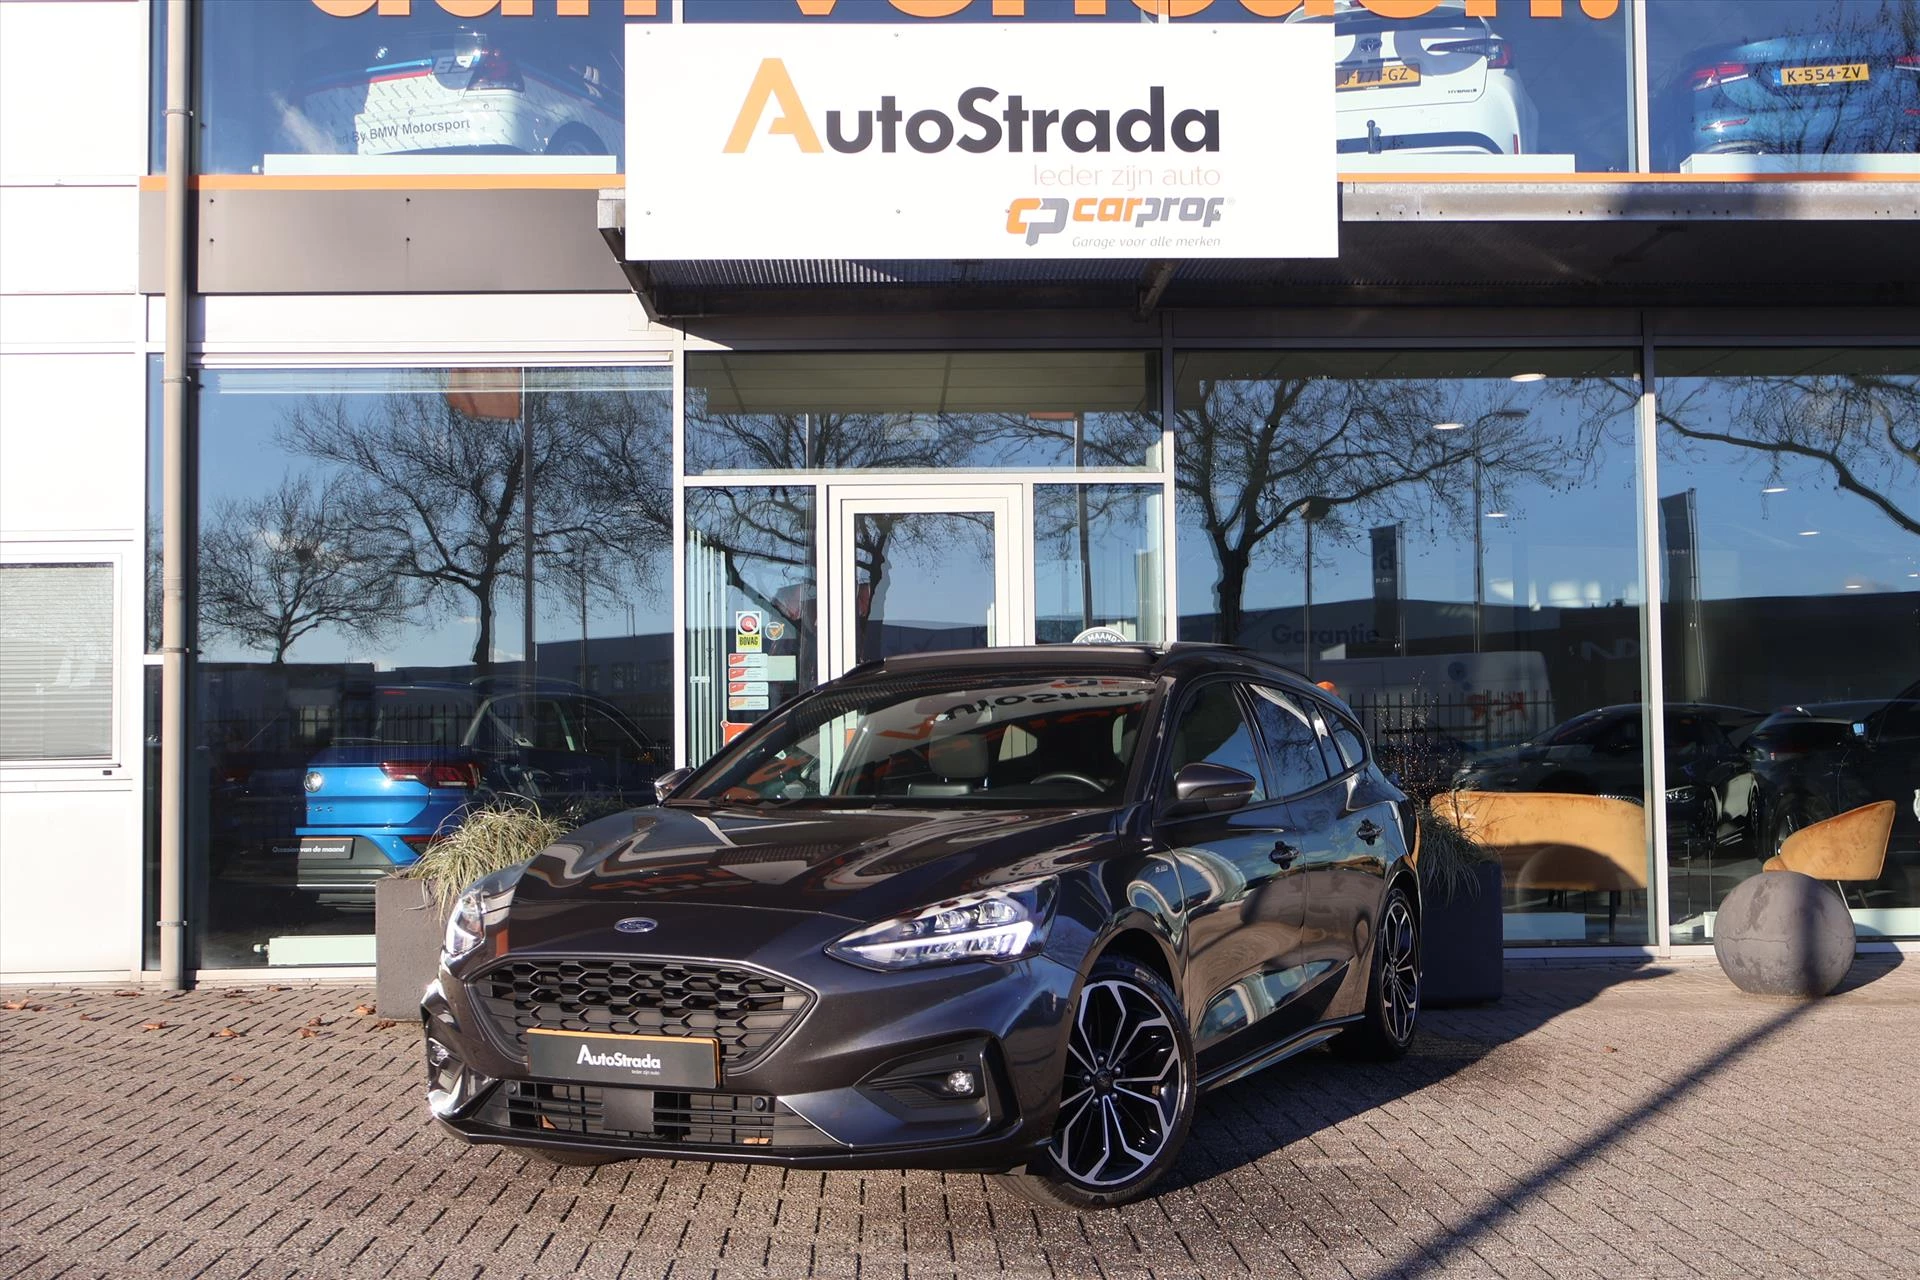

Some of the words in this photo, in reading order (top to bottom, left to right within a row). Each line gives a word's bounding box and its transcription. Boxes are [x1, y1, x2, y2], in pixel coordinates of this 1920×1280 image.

[1343, 67, 1408, 86] J-771-GZ
[1787, 66, 1860, 82] K-554-ZV
[722, 58, 1219, 154] AutoStrada
[352, 130, 367, 144] By
[370, 125, 399, 139] BMW
[402, 119, 471, 135] Motorsport
[1033, 164, 1103, 187] Ieder
[1111, 164, 1153, 191] zijn
[1162, 166, 1221, 187] auto
[1072, 236, 1116, 249] Garage
[1119, 238, 1148, 247] voor
[1150, 236, 1172, 248] alle
[1175, 236, 1221, 247] merken
[739, 636, 759, 646] BOVAG
[1271, 622, 1380, 645] Garantie
[312, 845, 322, 853] de
[322, 845, 346, 853] maand
[576, 1044, 661, 1069] AutoStrada
